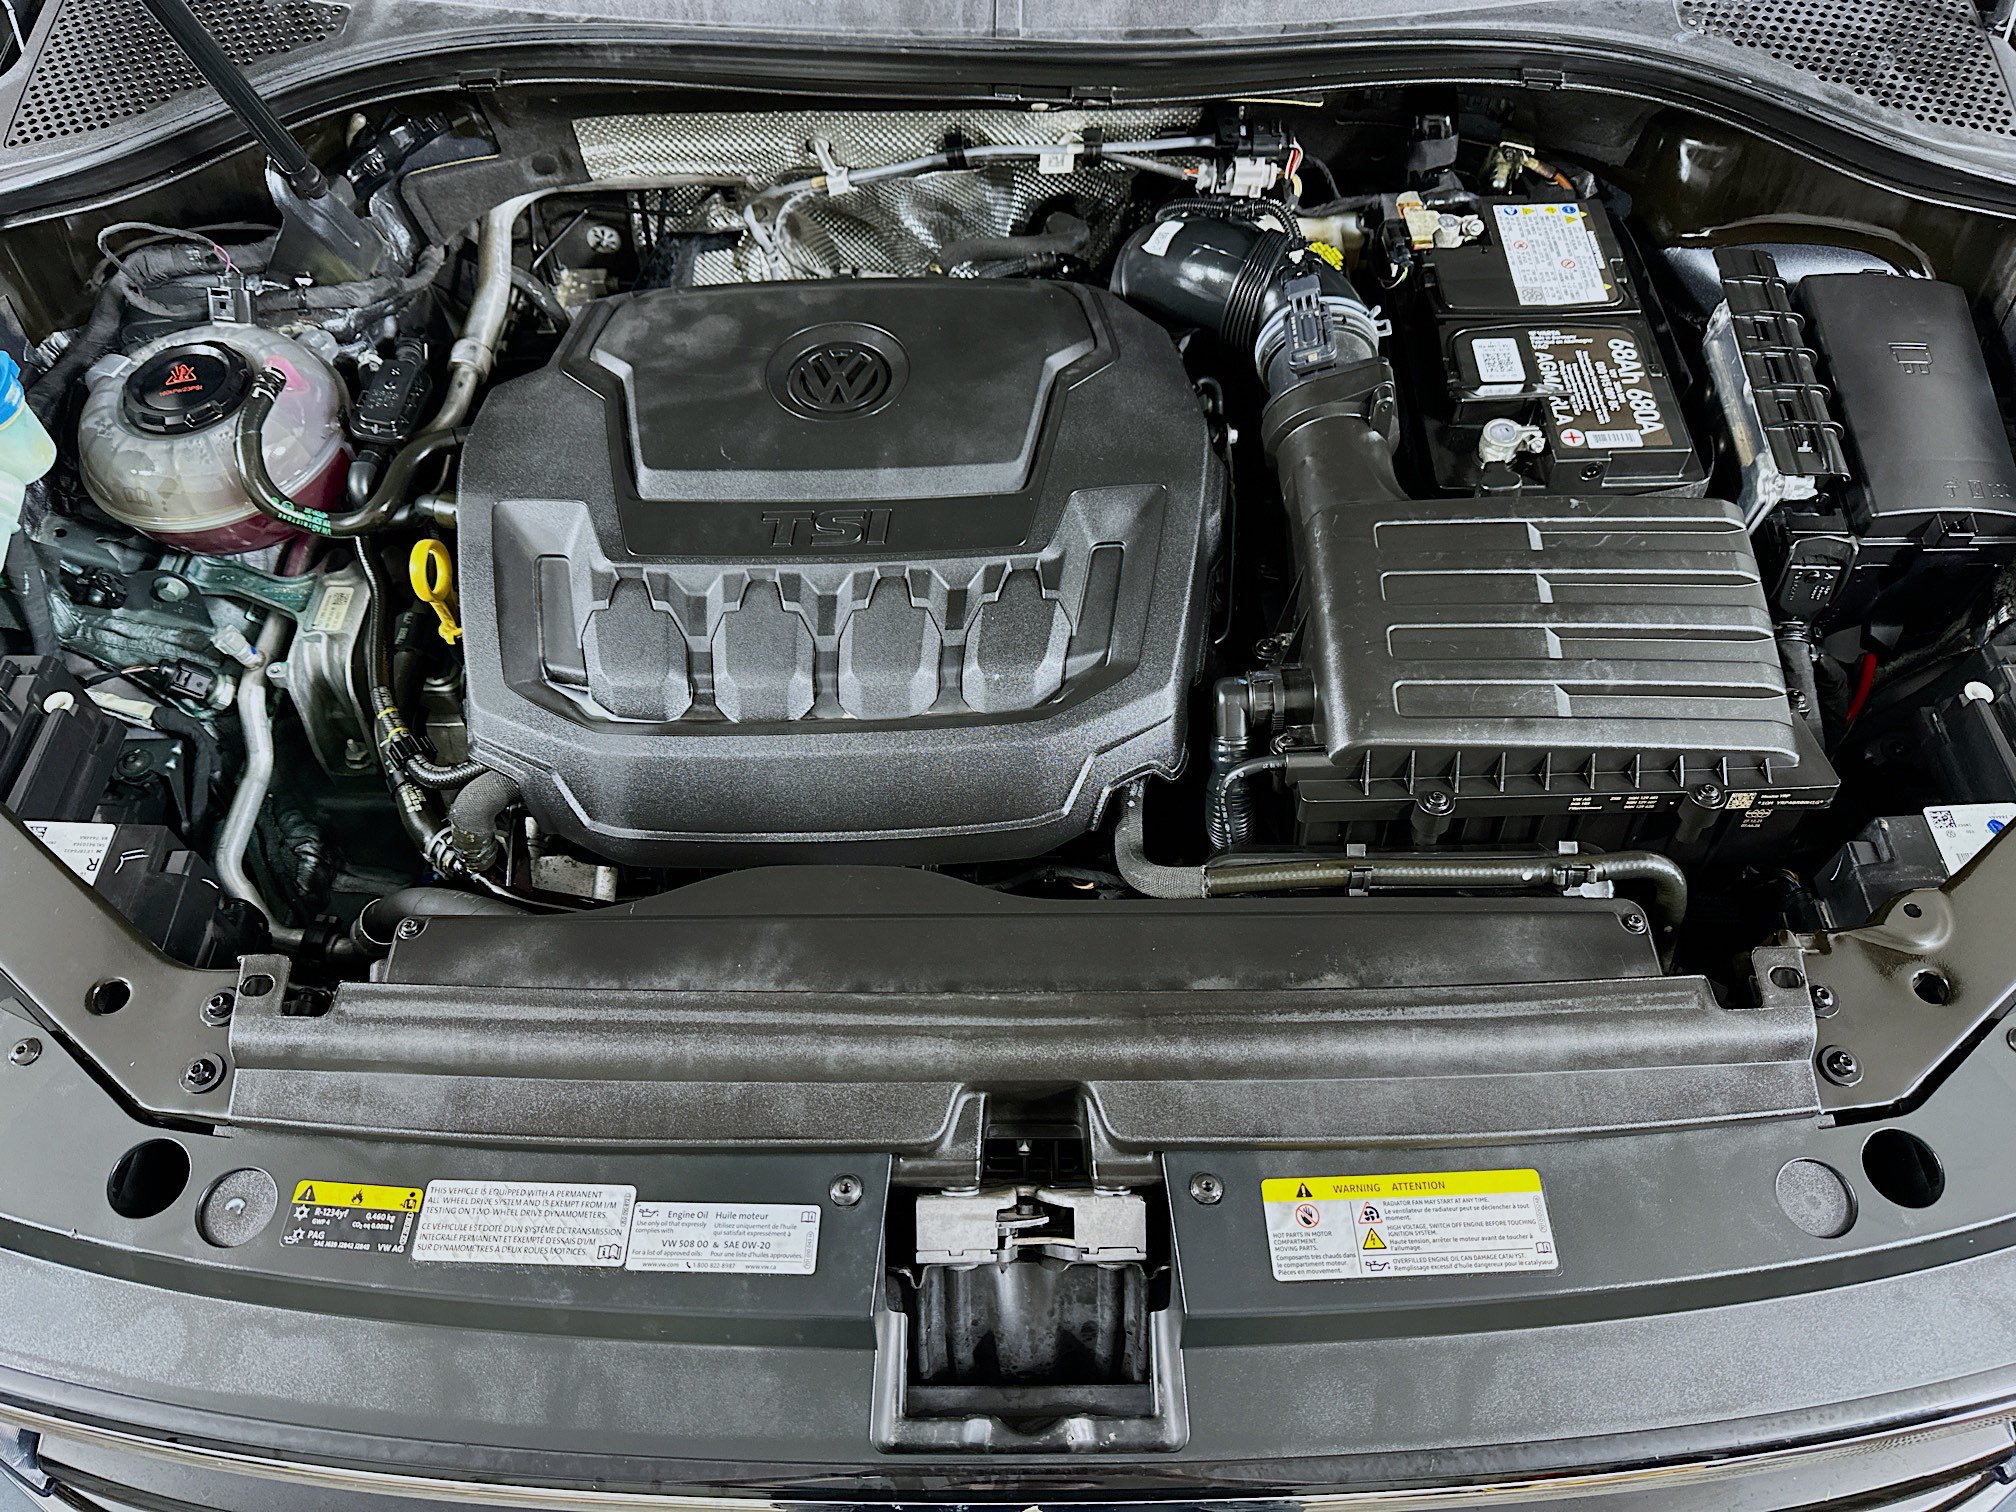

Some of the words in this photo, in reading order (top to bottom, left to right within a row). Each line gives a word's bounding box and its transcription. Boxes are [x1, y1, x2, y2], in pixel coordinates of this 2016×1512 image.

[1608, 338, 1644, 384] 68Ah
[1626, 388, 1664, 435] 680A
[761, 508, 892, 548] TSI
[1333, 1184, 1380, 1193] WARNING
[1392, 1182, 1446, 1191] ATTENTION
[448, 1187, 478, 1195] VEHICLE
[556, 1190, 603, 1198] PERMANENT
[551, 1200, 580, 1208] EXEMPT
[668, 1211, 695, 1220] Engine
[568, 1227, 622, 1236] TRANSMISSION
[736, 1223, 770, 1231] uniquement
[307, 1230, 326, 1240] PAG
[378, 1243, 391, 1253] VW
[392, 1245, 404, 1254] AG
[697, 1240, 708, 1248] 00
[524, 1246, 548, 1254] ROUES
